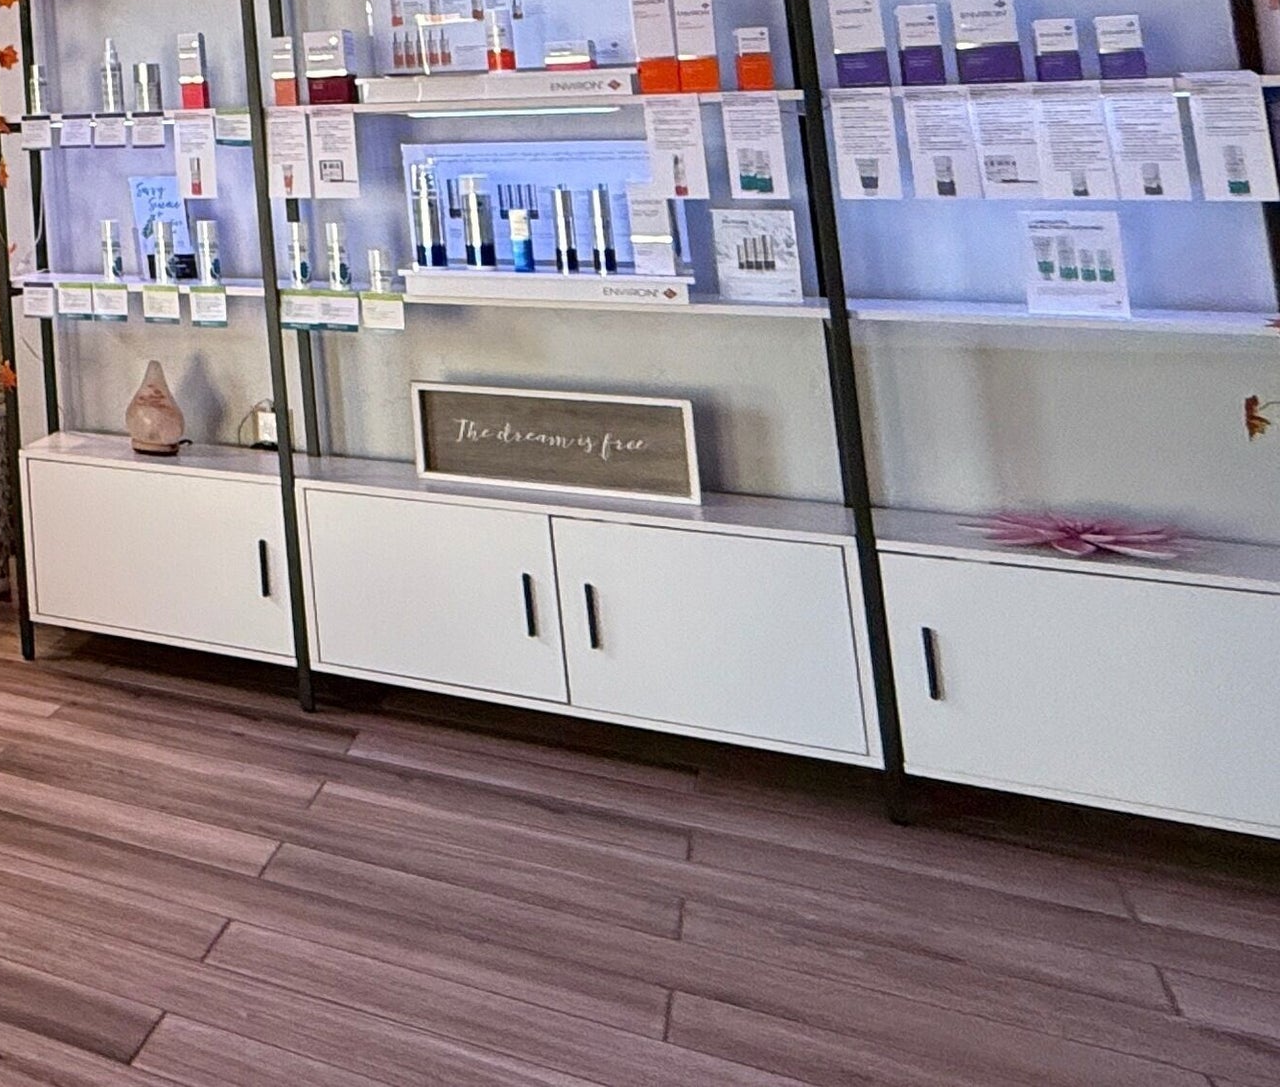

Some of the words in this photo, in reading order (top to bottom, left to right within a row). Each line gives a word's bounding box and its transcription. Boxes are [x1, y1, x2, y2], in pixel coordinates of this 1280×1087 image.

[452, 418, 493, 443] The
[496, 422, 575, 448] dream
[577, 434, 592, 453] is
[599, 433, 647, 461] free
